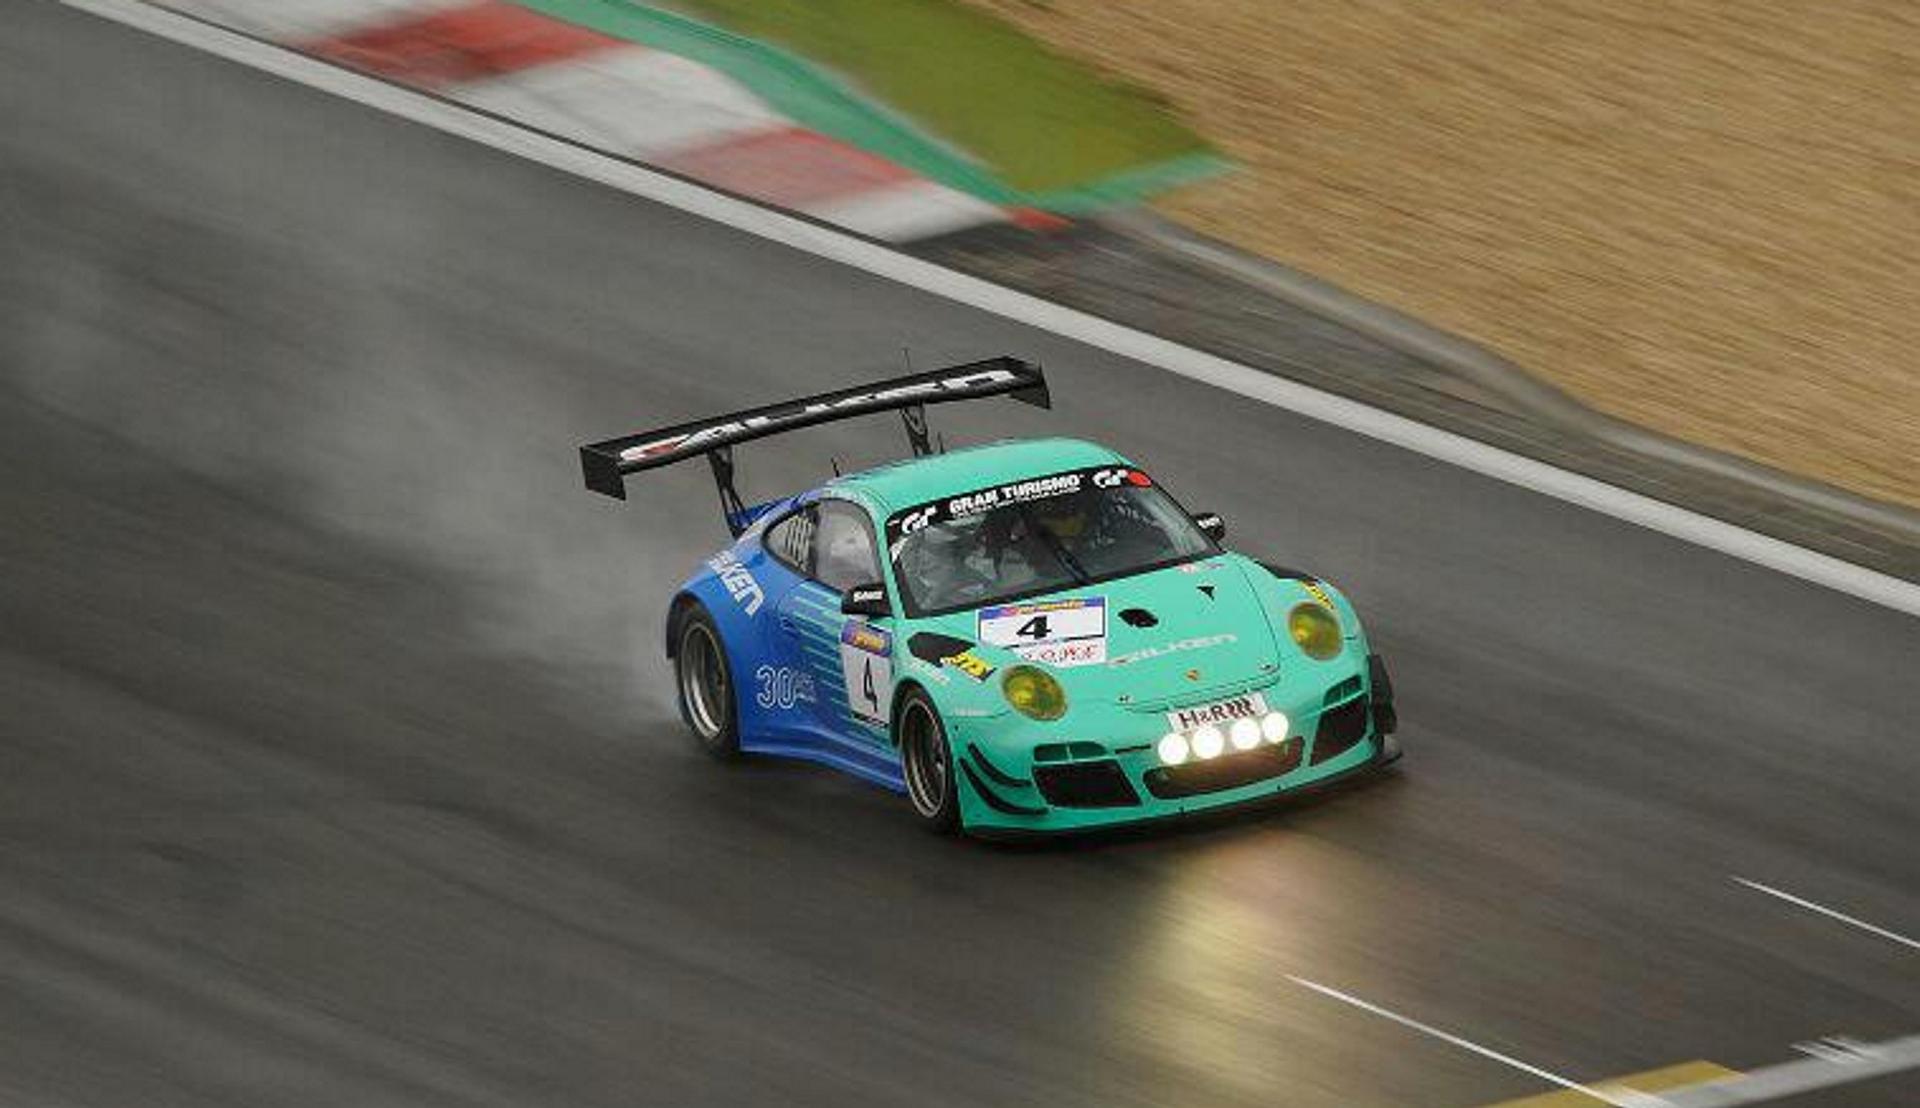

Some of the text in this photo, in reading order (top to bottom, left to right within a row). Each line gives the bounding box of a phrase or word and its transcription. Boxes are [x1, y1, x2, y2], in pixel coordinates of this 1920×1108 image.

[949, 489, 998, 515] GRAN
[1001, 474, 1080, 500] TURISMO
[1016, 615, 1052, 640] 4
[755, 665, 797, 710] 30
[863, 656, 879, 713] 4
